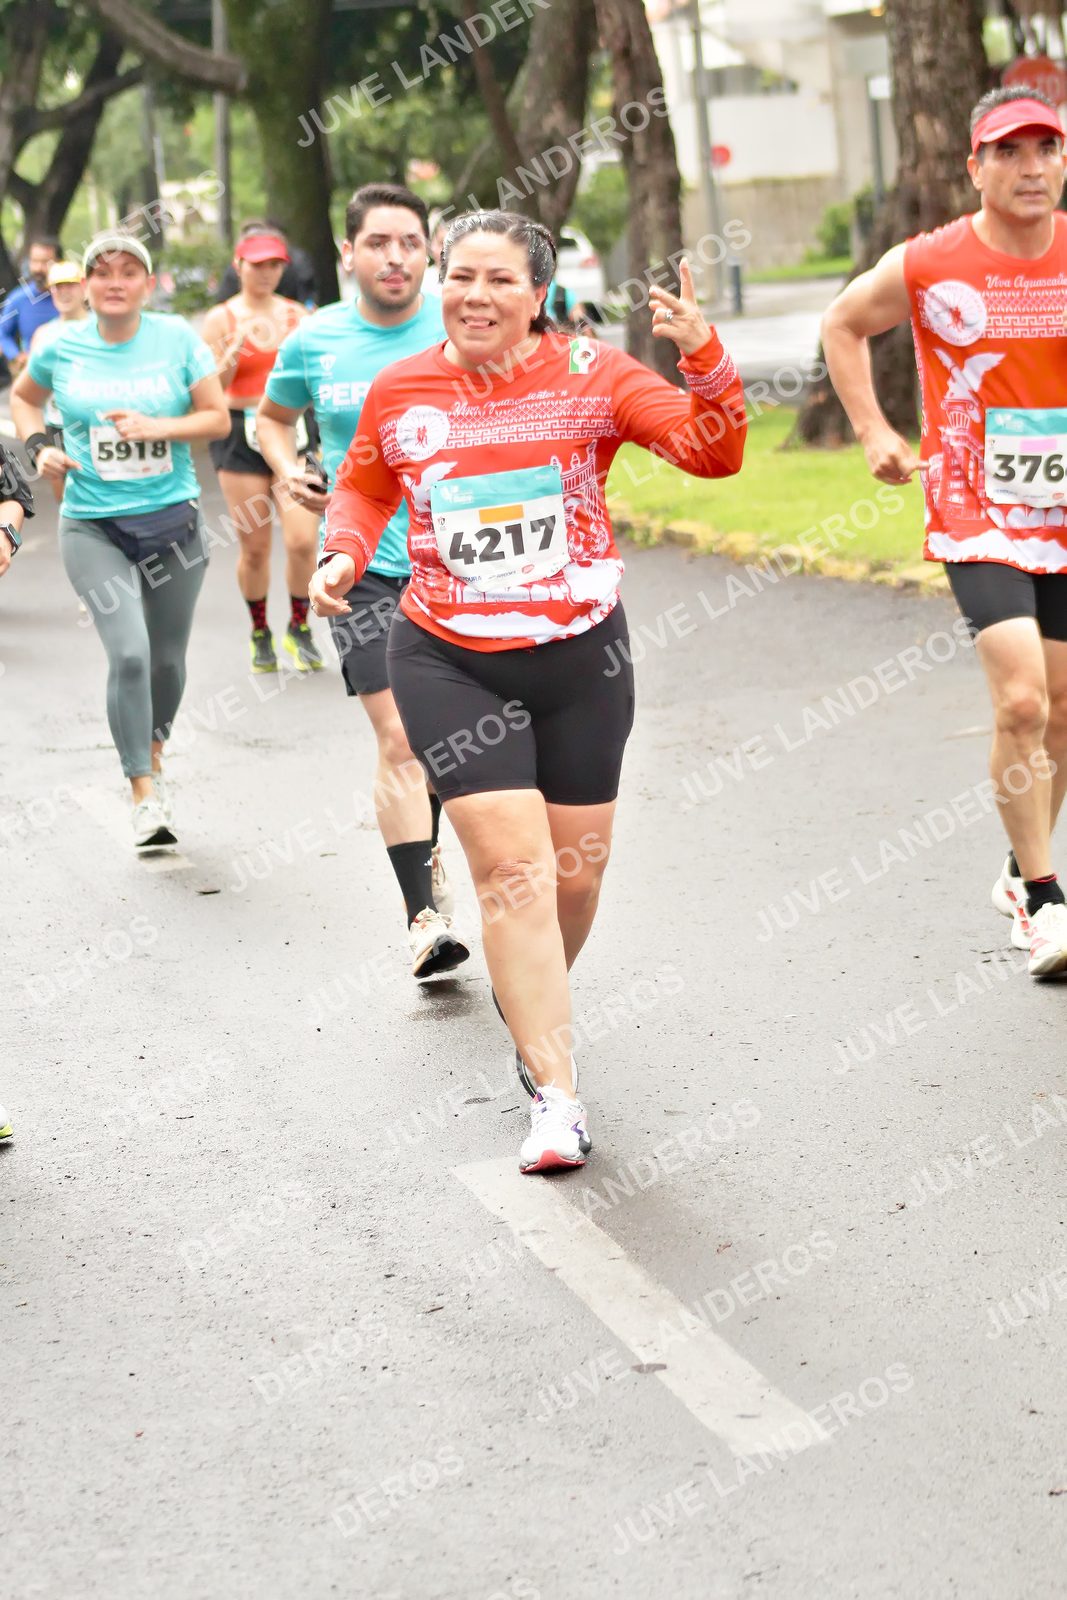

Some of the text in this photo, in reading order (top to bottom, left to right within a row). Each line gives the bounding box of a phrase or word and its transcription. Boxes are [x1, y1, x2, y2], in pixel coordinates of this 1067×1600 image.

[985, 276, 1010, 289] Viva
[98, 440, 167, 461] 5918
[993, 453, 1067, 483] 376
[449, 515, 556, 565] 4217
